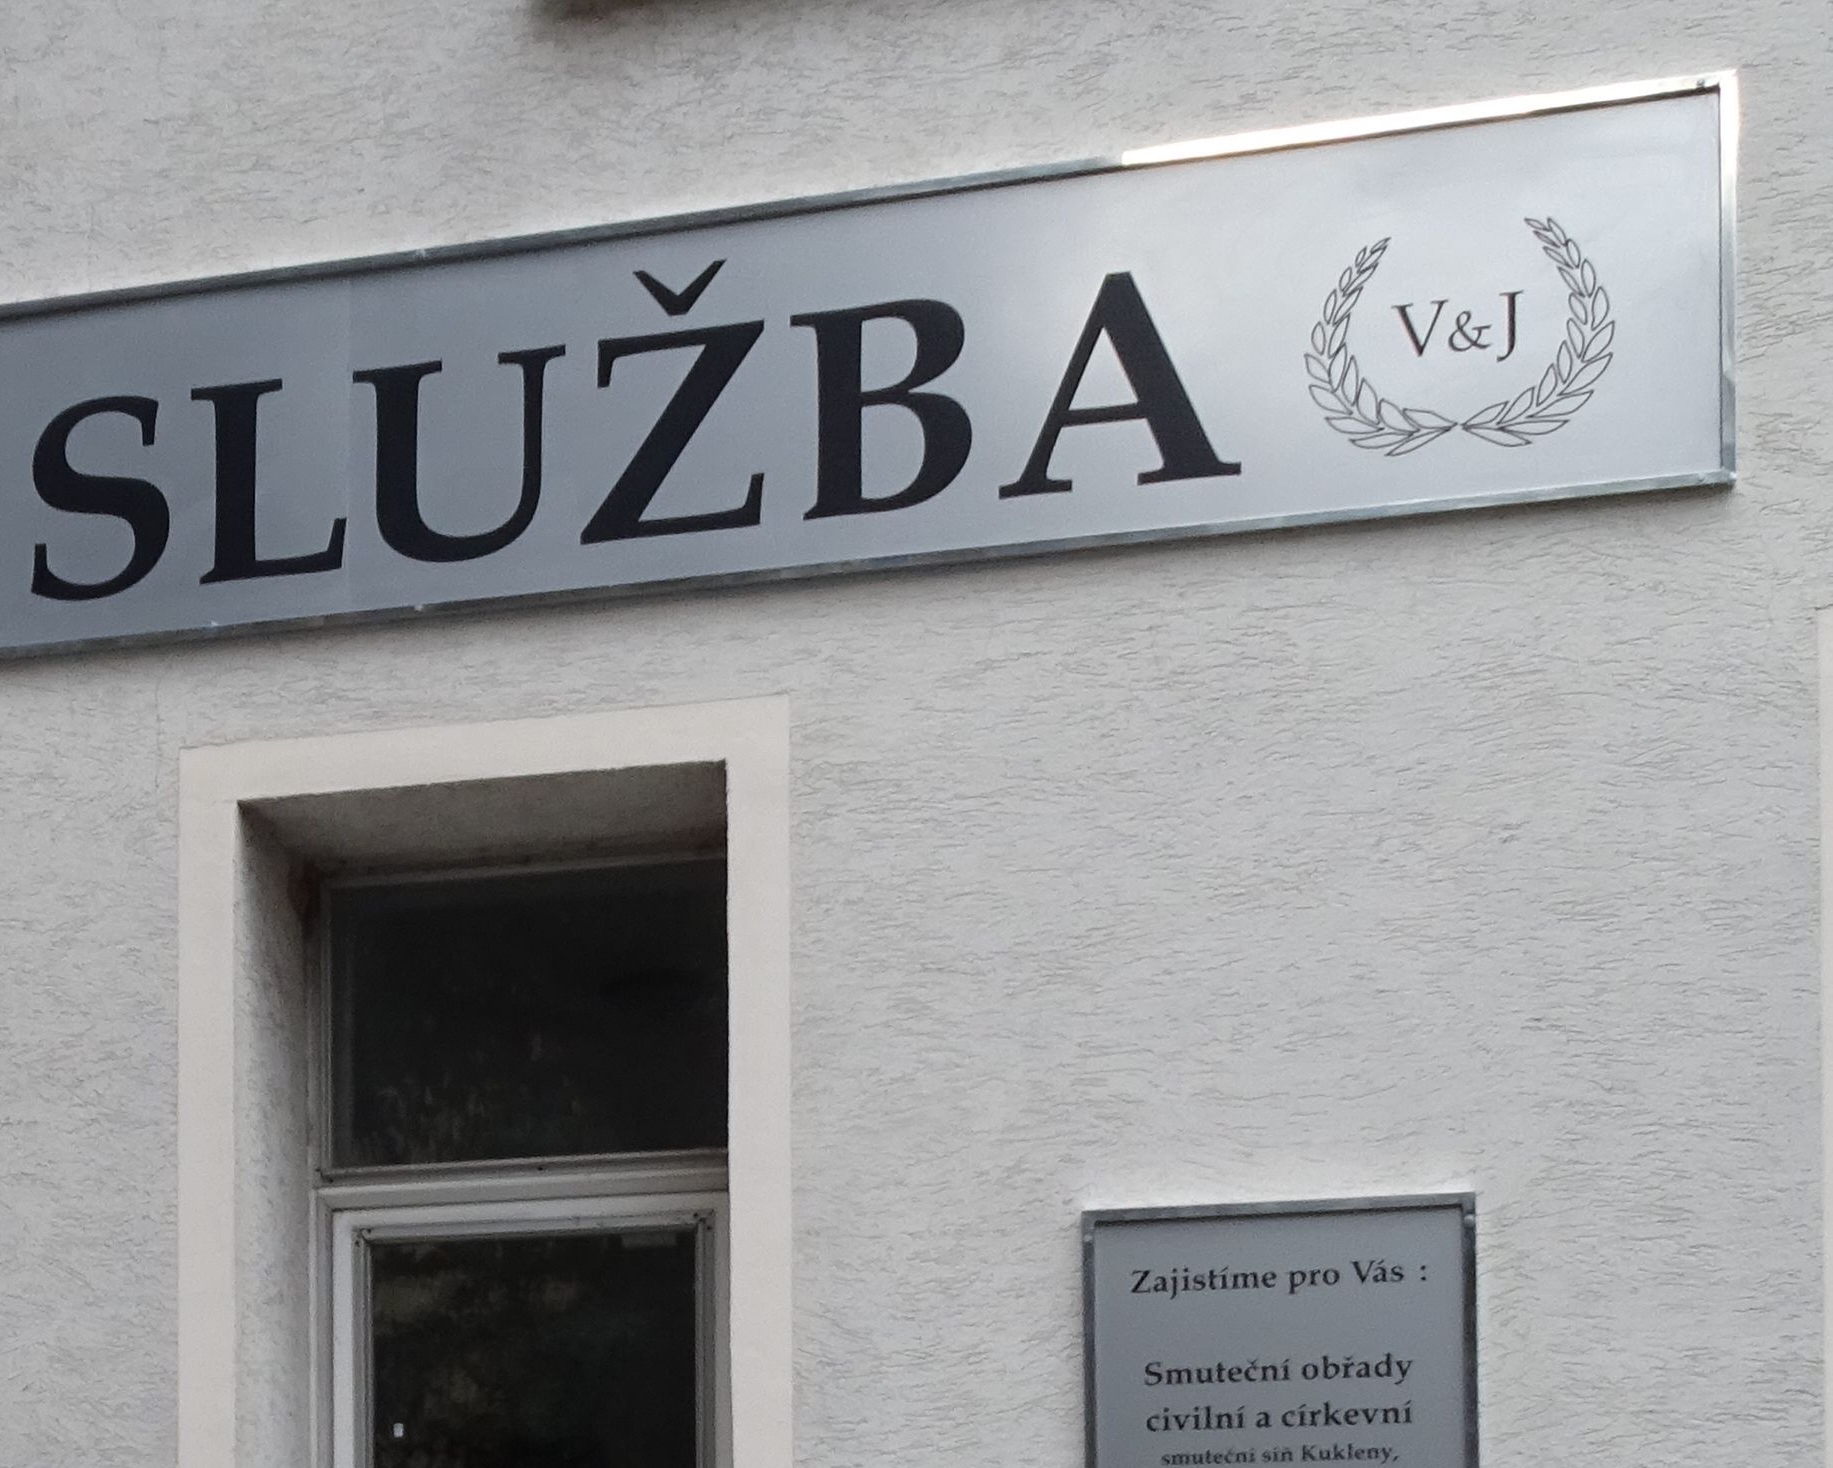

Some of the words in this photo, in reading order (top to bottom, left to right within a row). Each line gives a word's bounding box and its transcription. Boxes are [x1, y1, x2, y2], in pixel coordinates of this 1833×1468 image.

[1391, 290, 1524, 361] V&J
[30, 258, 1243, 601] SLUŽBA
[1130, 1265, 1277, 1300] Zajistíme
[1287, 1270, 1340, 1294] pro
[1352, 1260, 1405, 1284] Vás
[1144, 1359, 1291, 1387] Smuteční
[1301, 1353, 1414, 1385] obřady
[1146, 1405, 1246, 1432] civilní
[1256, 1410, 1272, 1428] a
[1281, 1400, 1413, 1428] církevní
[1160, 1445, 1256, 1467] smuteční
[1301, 1443, 1399, 1464] Kukleny,
